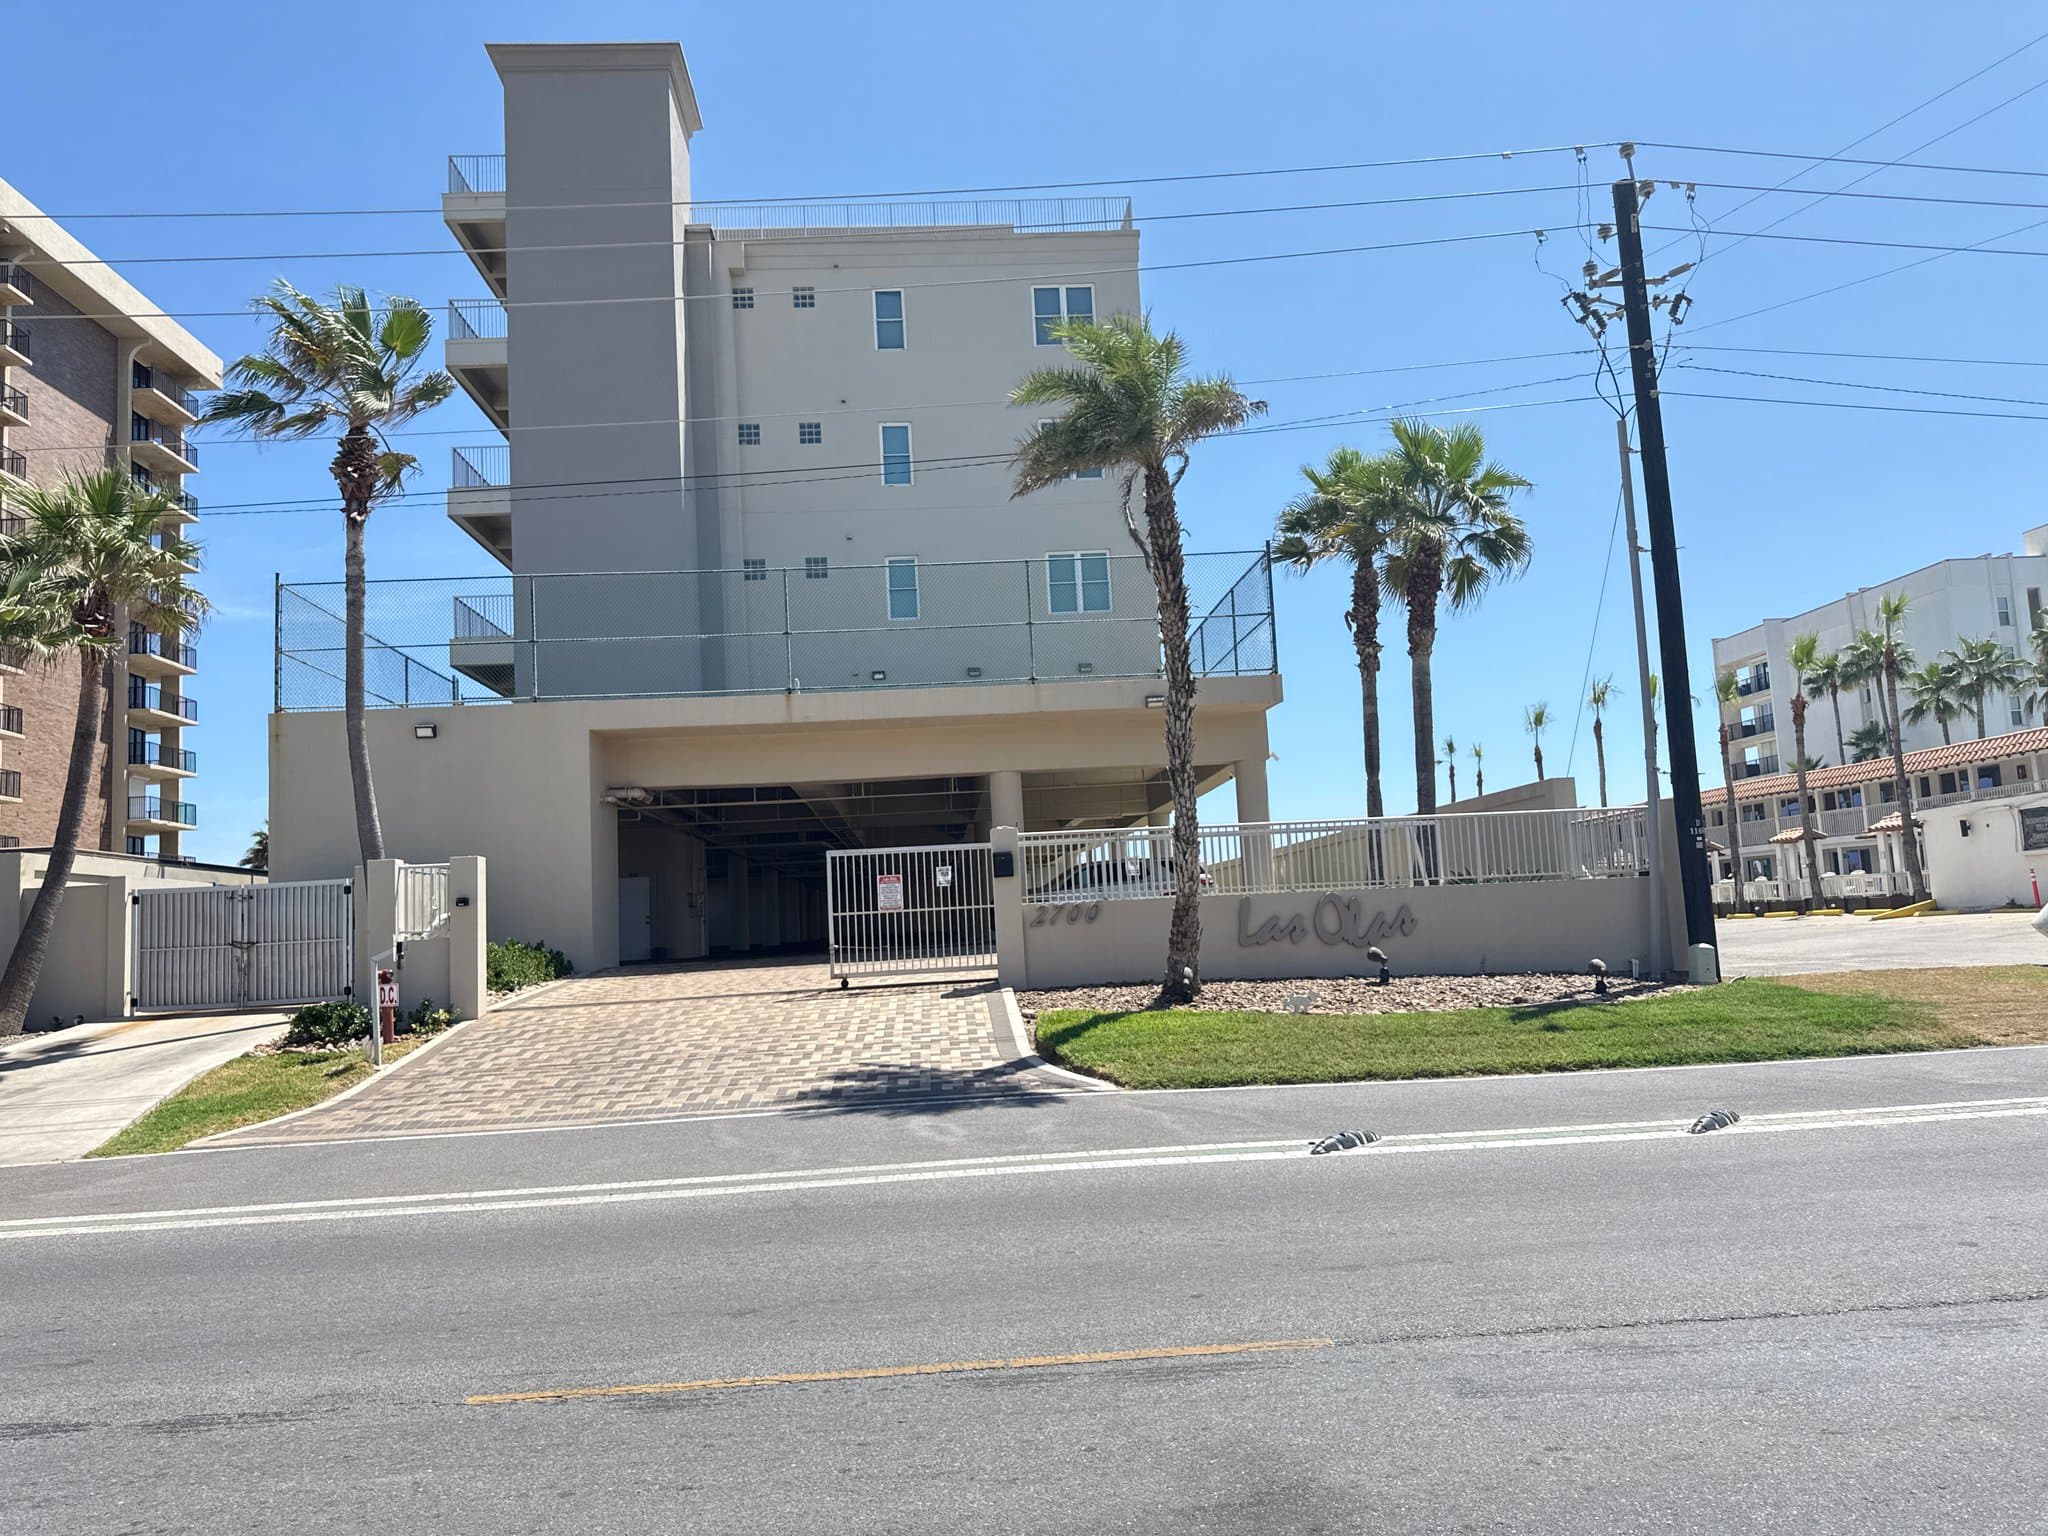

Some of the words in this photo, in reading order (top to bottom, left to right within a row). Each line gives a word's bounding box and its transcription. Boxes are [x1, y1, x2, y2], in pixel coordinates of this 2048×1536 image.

[1030, 903, 1103, 928] 2700
[1238, 894, 1310, 947] Las
[1313, 891, 1419, 948] Olas
[380, 987, 397, 1004] D.C.
